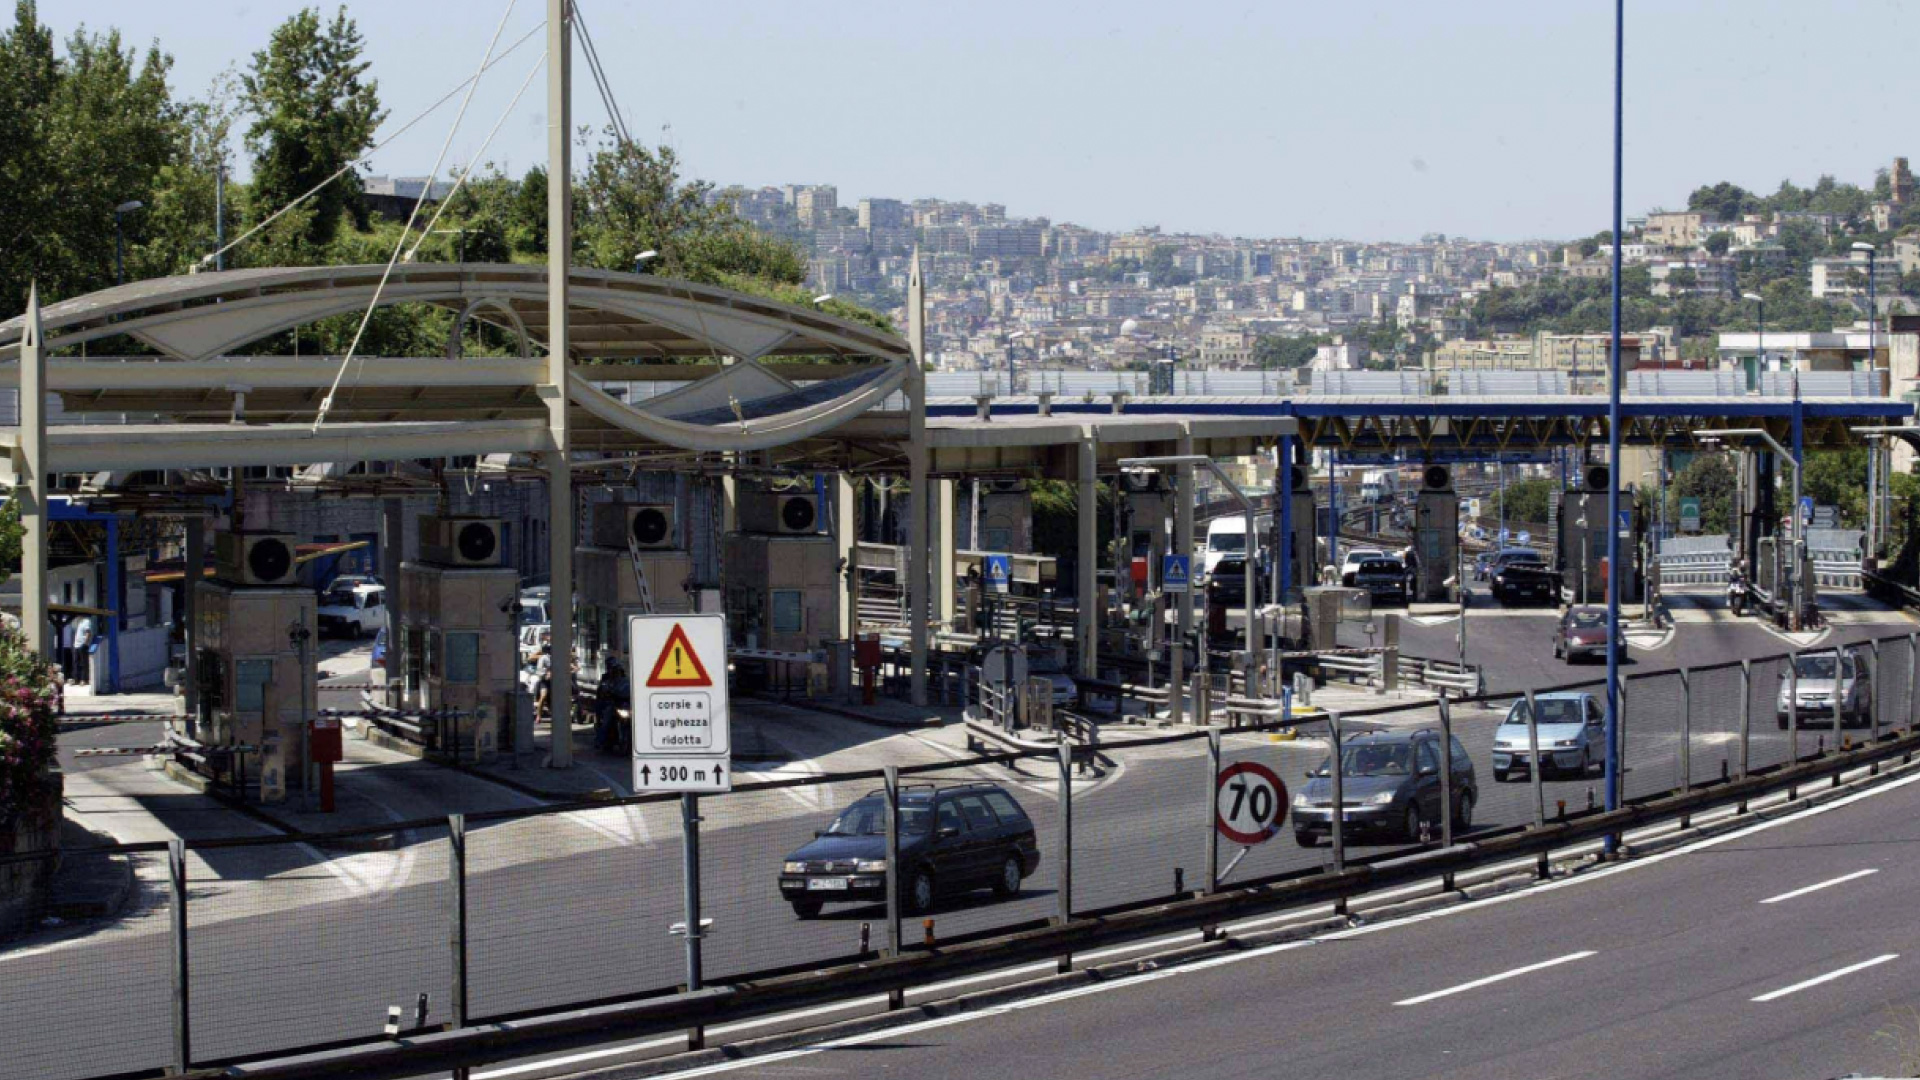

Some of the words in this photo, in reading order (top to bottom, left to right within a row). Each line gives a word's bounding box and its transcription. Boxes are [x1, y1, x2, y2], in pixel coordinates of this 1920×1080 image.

[657, 699, 691, 709] corsie
[696, 701, 703, 709] a
[653, 718, 708, 728] larghezza
[662, 735, 701, 744] ridotta
[660, 767, 688, 781] 300
[695, 770, 705, 781] m
[1229, 784, 1272, 823] 70
